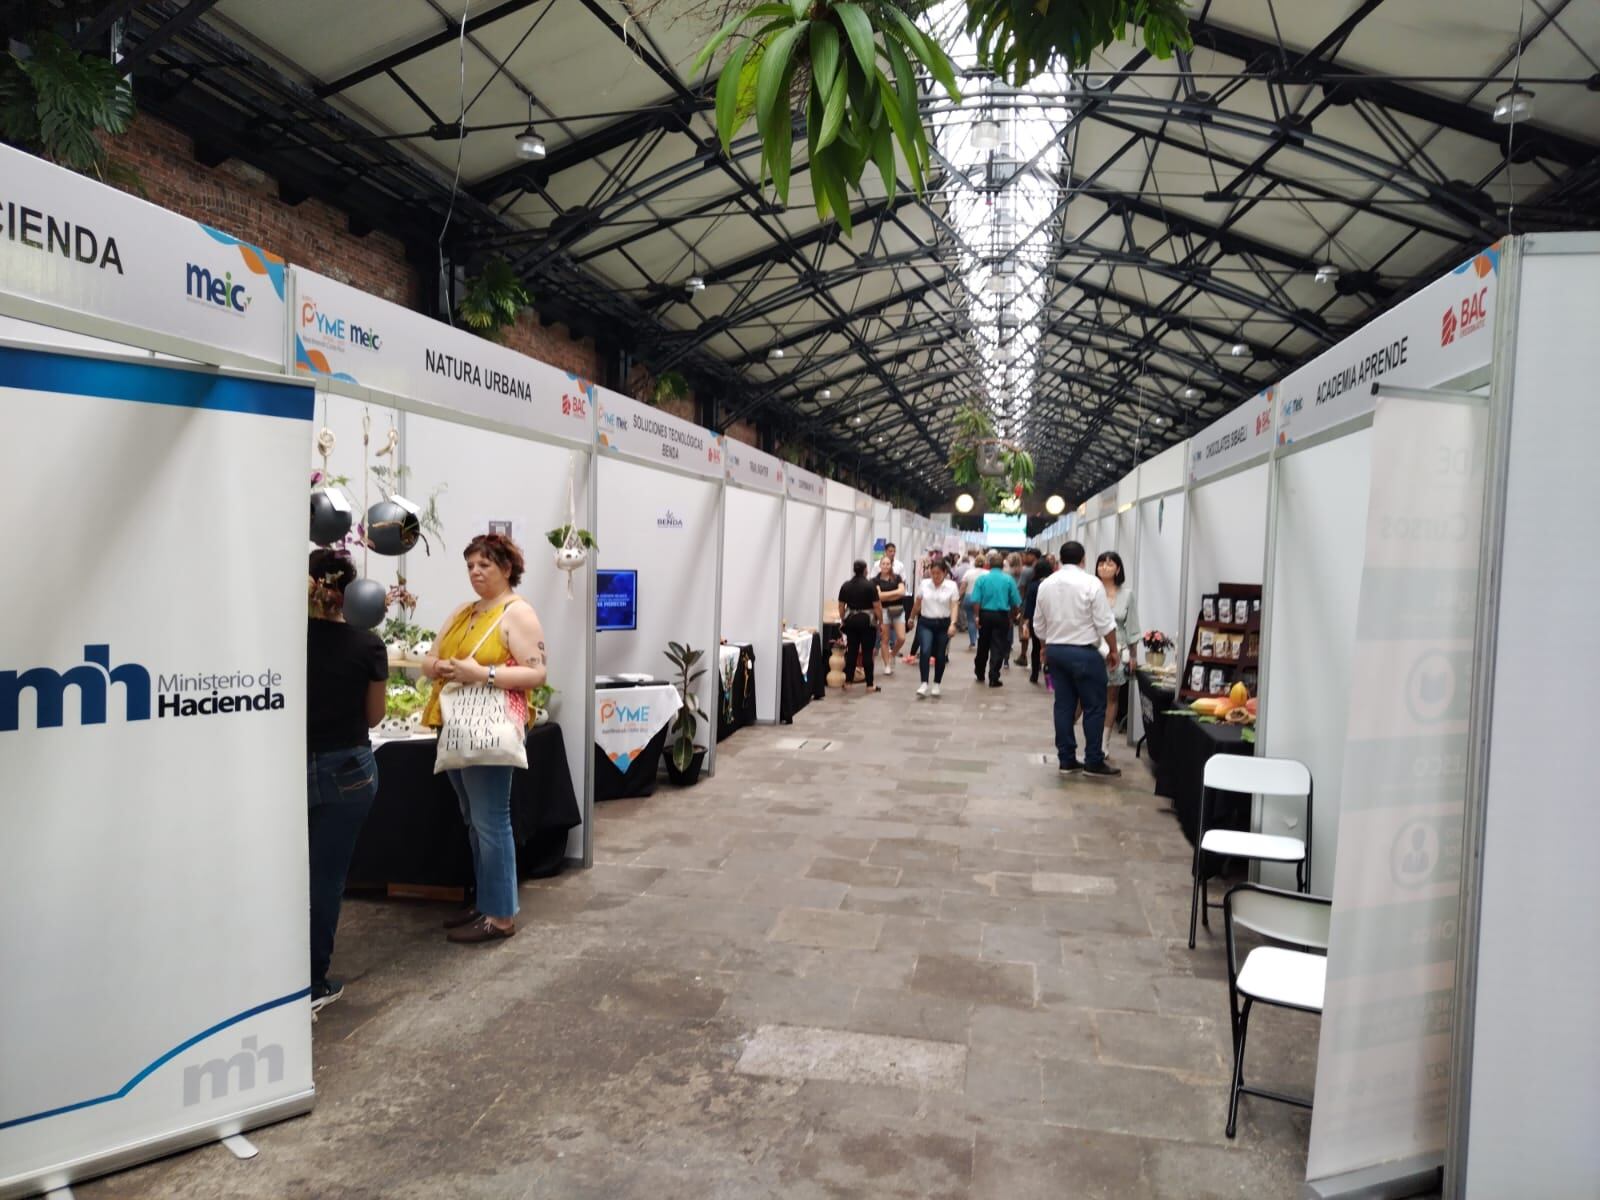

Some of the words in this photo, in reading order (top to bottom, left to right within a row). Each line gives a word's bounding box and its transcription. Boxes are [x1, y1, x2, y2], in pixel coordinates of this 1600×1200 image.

[1461, 286, 1488, 328] BAC
[302, 302, 345, 340] PYME
[425, 348, 482, 388] NATURA
[484, 368, 533, 403] URBANA
[1315, 364, 1357, 406] ACADEMIA
[1358, 335, 1409, 386] APRENDE
[572, 396, 587, 416] BAC
[633, 413, 669, 440] SOLUCIONES
[661, 442, 680, 459] BENDA
[656, 517, 684, 526] BENDA
[157, 670, 255, 693] Ministerio
[257, 667, 282, 688] de
[158, 687, 285, 719] Hacienda
[600, 702, 651, 724] PYME
[447, 716, 507, 727] OOLONG
[447, 726, 493, 740] BLACK
